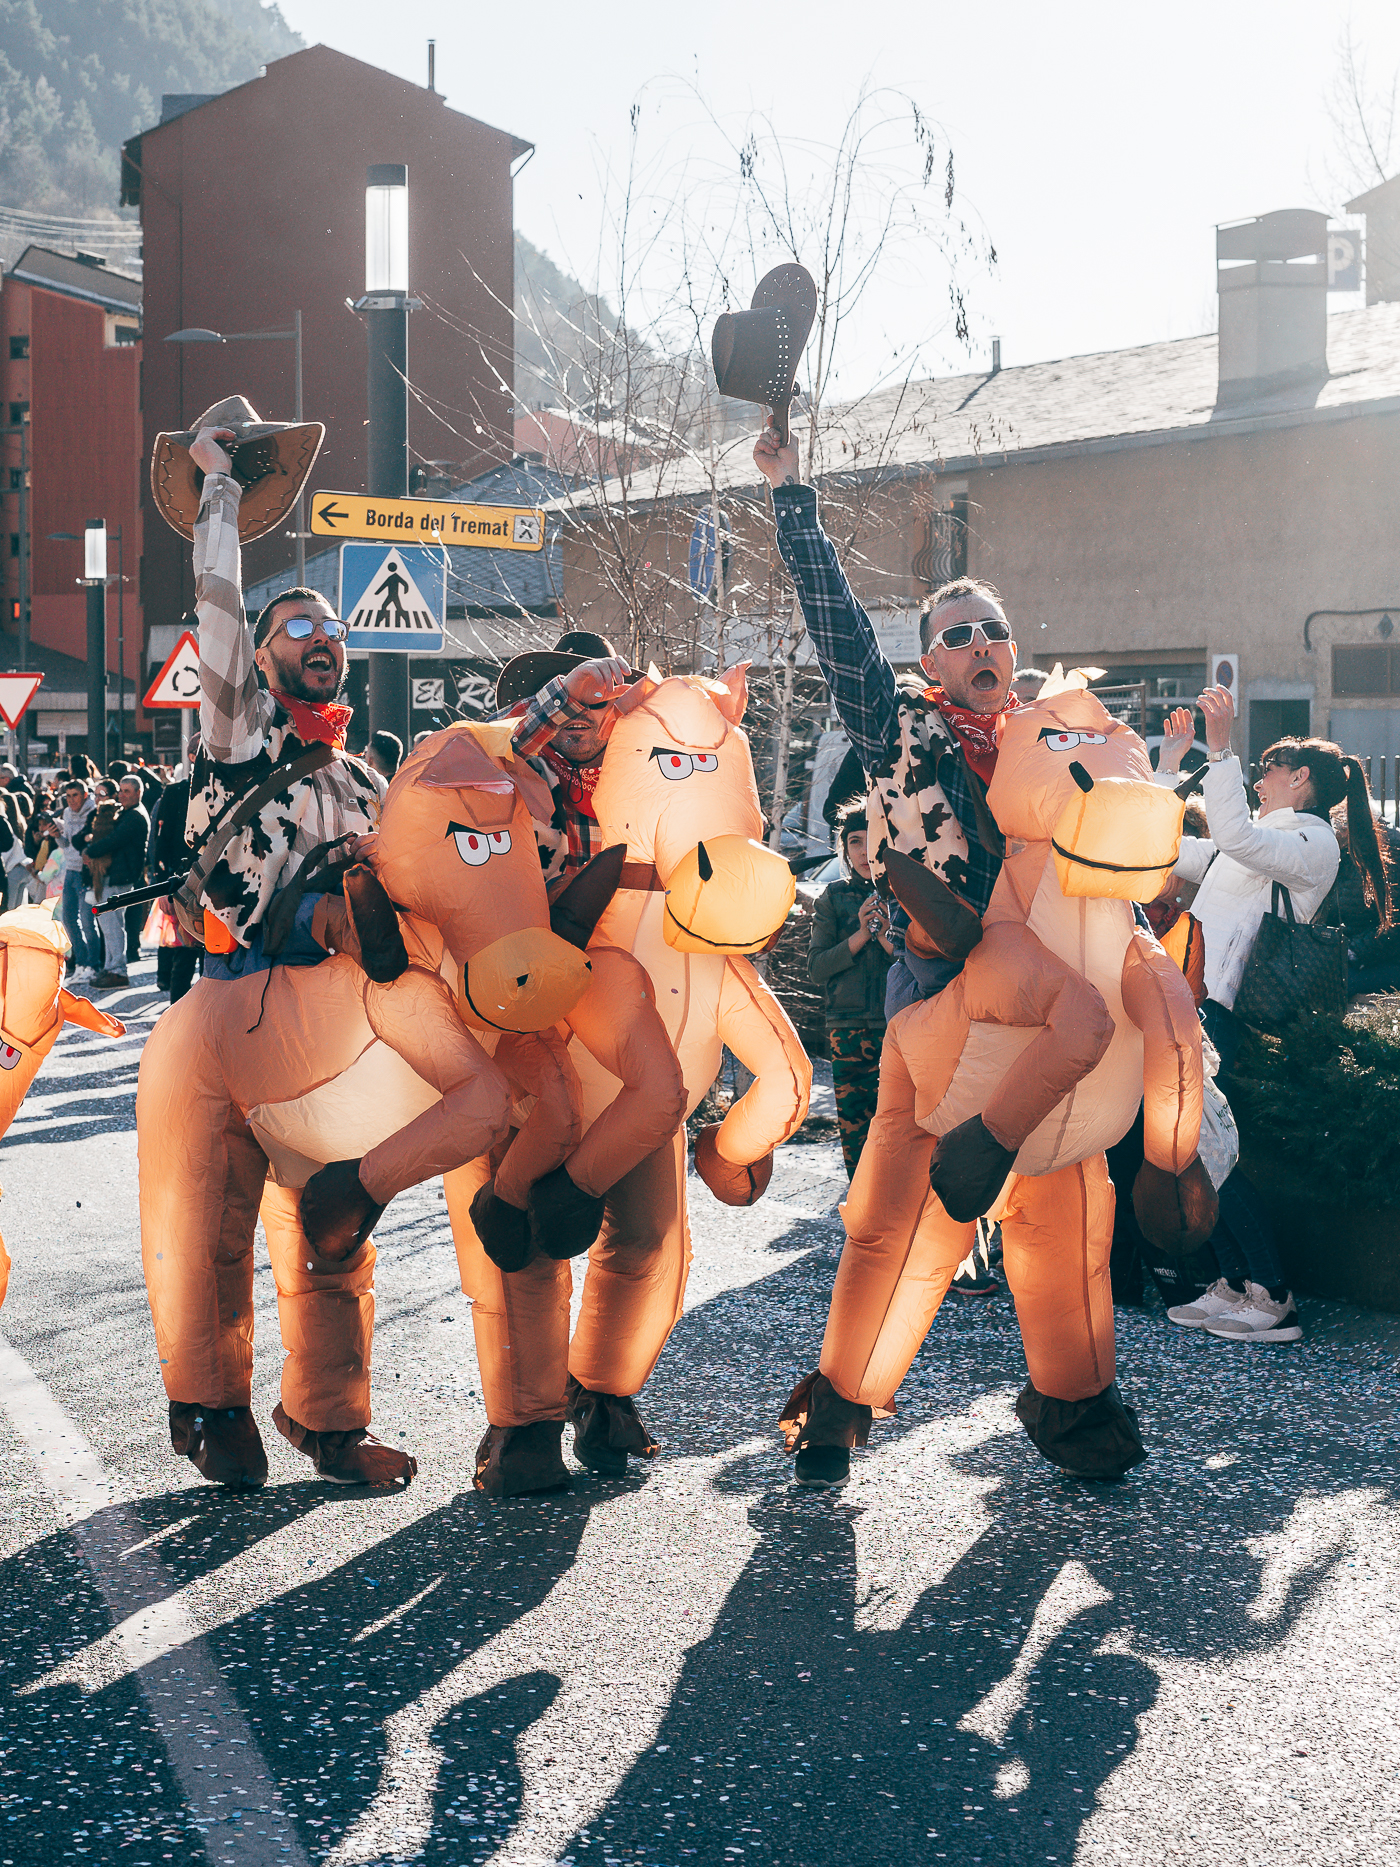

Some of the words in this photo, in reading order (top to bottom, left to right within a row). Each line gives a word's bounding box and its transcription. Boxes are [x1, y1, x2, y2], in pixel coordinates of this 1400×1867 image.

[1328, 236, 1355, 286] P
[366, 509, 414, 529] Borda
[420, 513, 445, 532] del
[451, 515, 509, 537] Tremat
